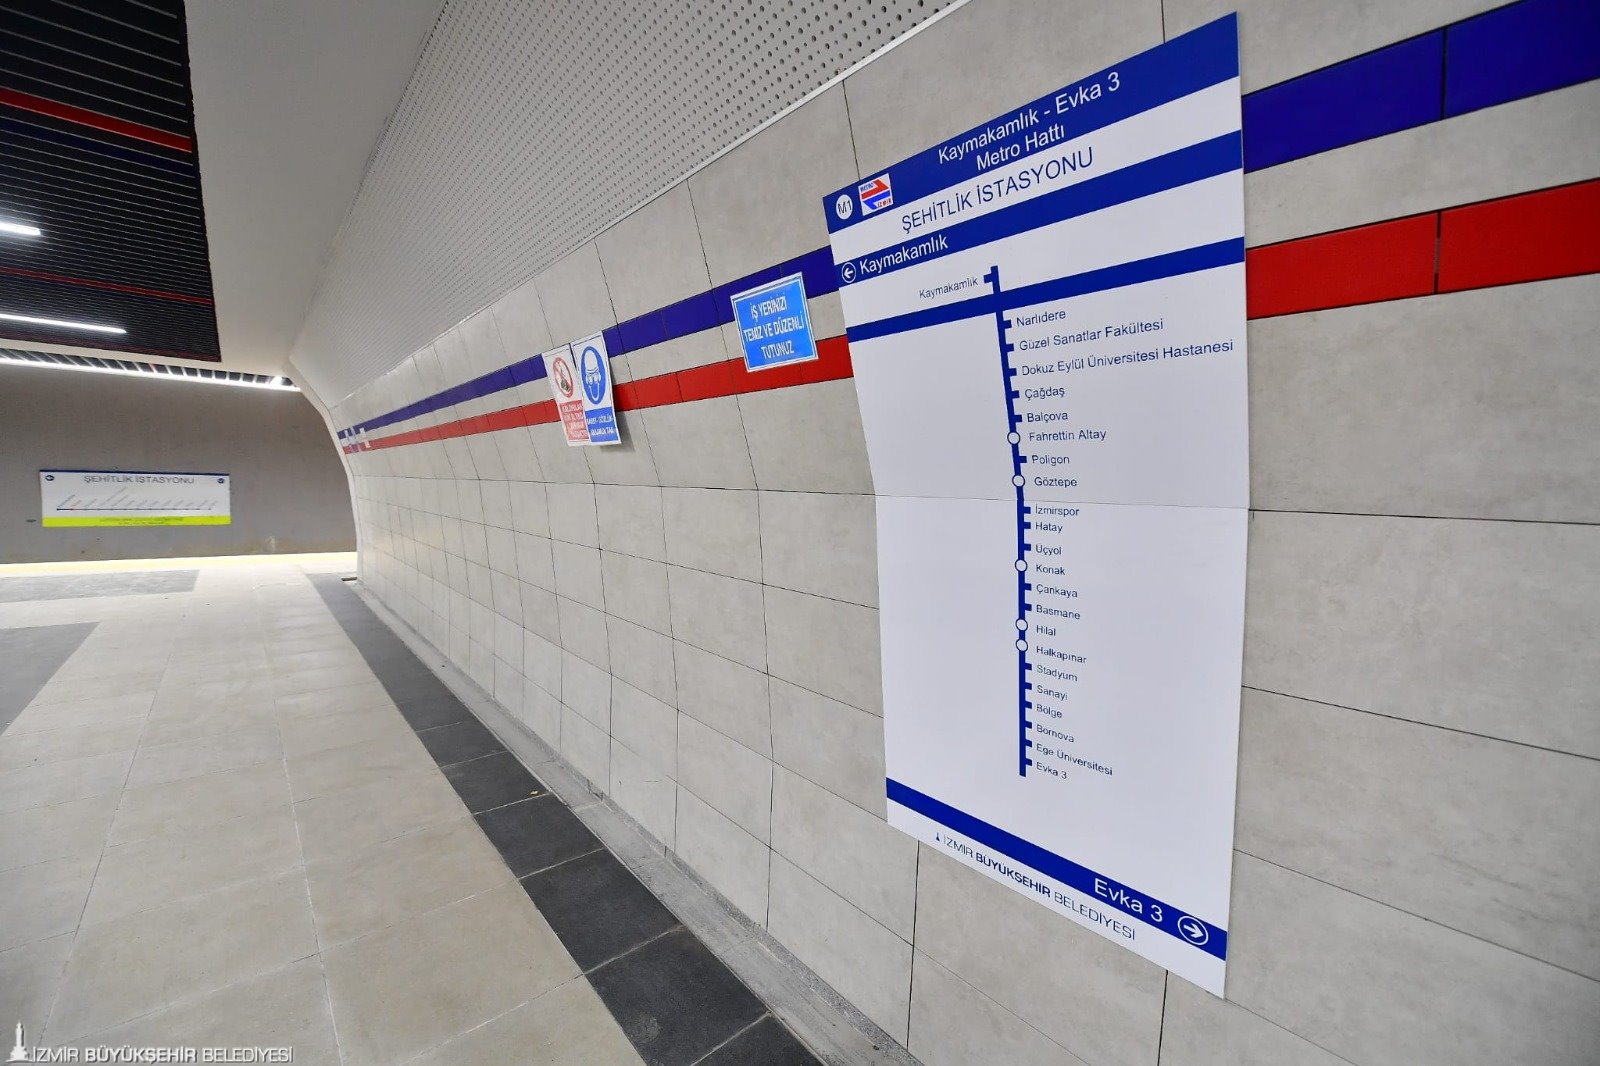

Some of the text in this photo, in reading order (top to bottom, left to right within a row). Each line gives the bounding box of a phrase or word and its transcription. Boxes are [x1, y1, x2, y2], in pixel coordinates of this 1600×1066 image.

[938, 108, 1040, 164] Kaymakamlık
[1055, 83, 1102, 115] Evka
[1107, 71, 1121, 92] 3
[976, 123, 1066, 171] Metro Hattı
[901, 146, 1094, 235] ŞEHİTLİK İSTASYONU
[837, 200, 852, 215] M1
[859, 234, 949, 275] Kaymakamlık
[918, 276, 979, 300] Kaymakamlık
[749, 302, 759, 323] İŞ
[1016, 309, 1067, 328] Narlıdere
[743, 311, 805, 342] TEMİZ VE DÜZENLİ
[1019, 318, 1164, 352] Güzel Sanatlar Fakültesi
[760, 340, 795, 360] TUTUNUZ
[1022, 339, 1234, 377] Dokuz Eylül Üniversitesi Hastanesi
[1024, 386, 1065, 401] Çağdaş
[1026, 411, 1069, 423] Balçova
[1029, 429, 1107, 442] Fahrettin Altay
[1031, 454, 1070, 466] Poligon
[83, 475, 133, 484] ŞEHİTLİK
[1034, 476, 1078, 489] Göztepe
[1035, 503, 1080, 517] İzmirspor
[1035, 521, 1063, 533] Hatay
[1035, 564, 1066, 576] Konak
[1036, 583, 1078, 598] Çankaya
[1036, 604, 1081, 620] Basmane
[1036, 624, 1056, 637] Hilal
[1036, 664, 1078, 682] Stadyum
[1036, 684, 1068, 701] Sanayi
[1036, 703, 1063, 719] Bölge
[1036, 723, 1075, 743] Bornova
[1036, 743, 1113, 776] Ege Üniversitesi
[1036, 761, 1068, 780] Evka 3
[1094, 877, 1163, 922] Evka 3
